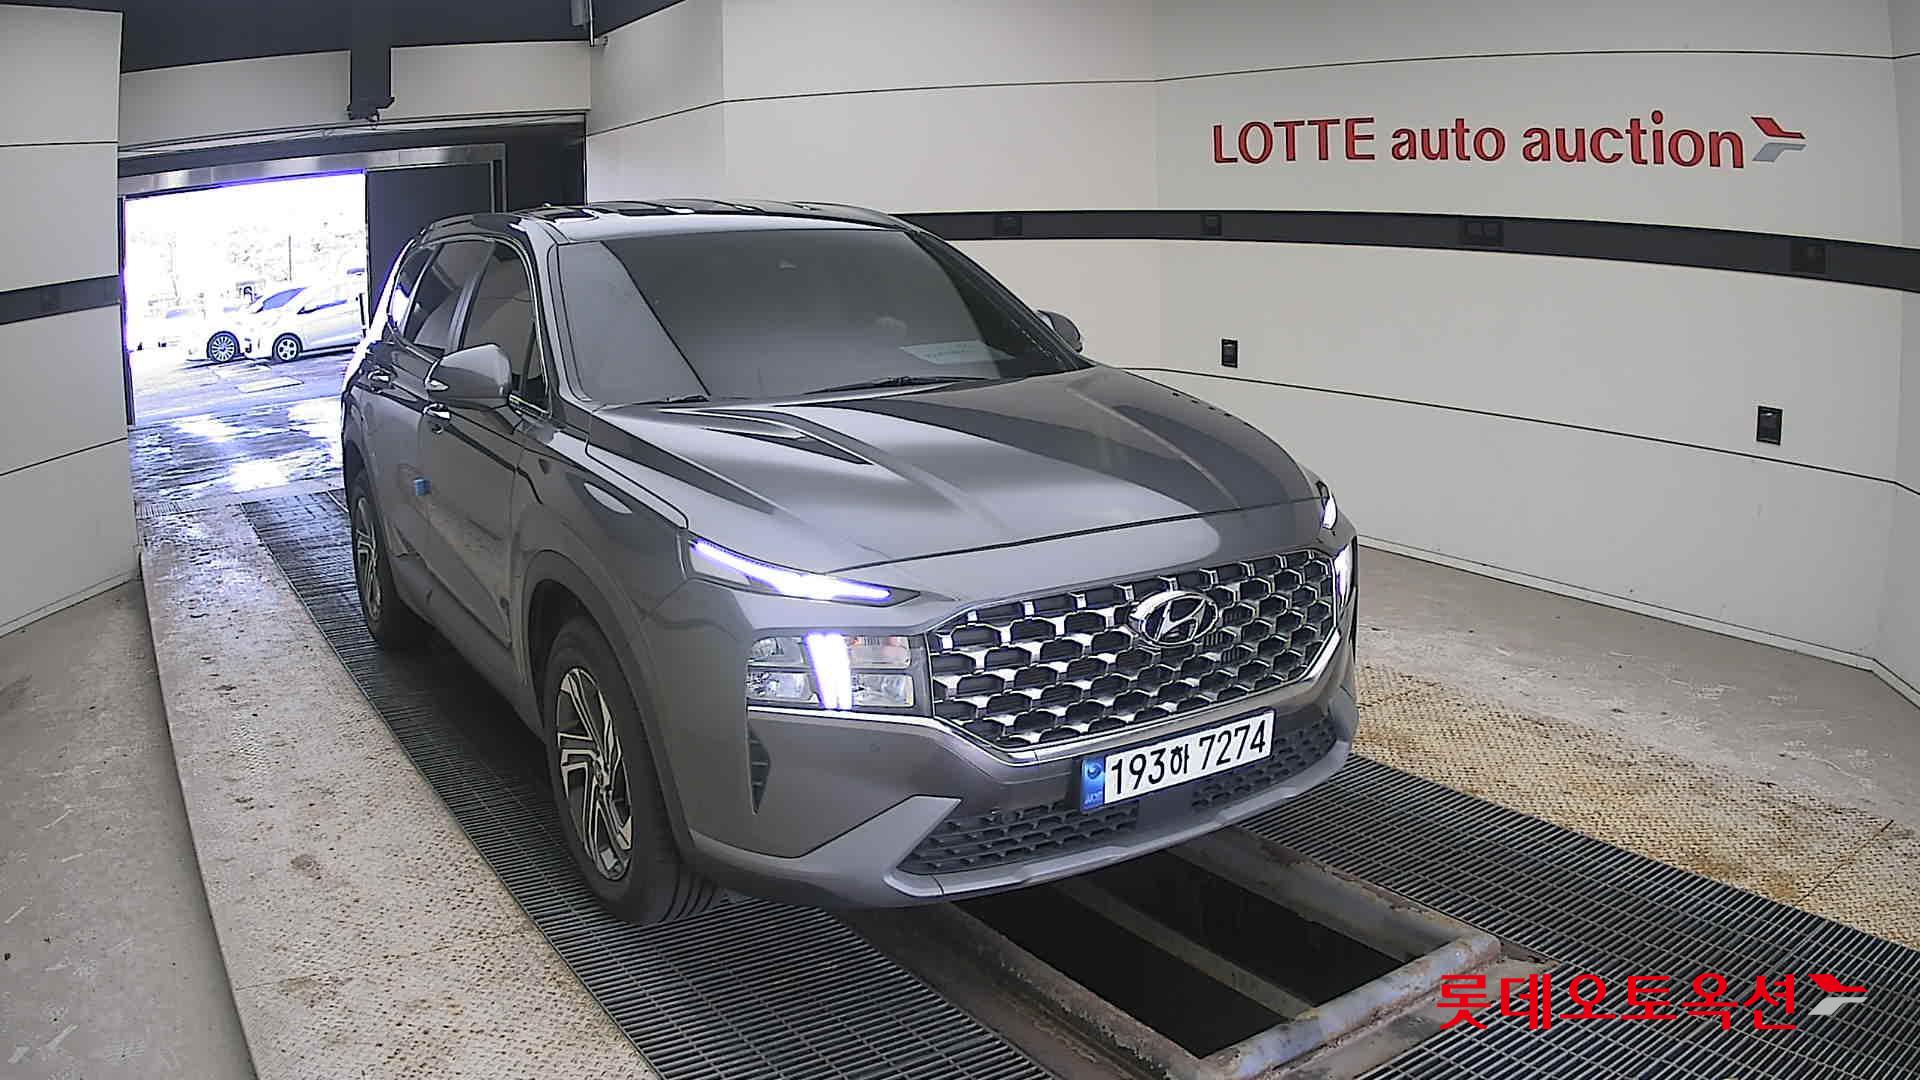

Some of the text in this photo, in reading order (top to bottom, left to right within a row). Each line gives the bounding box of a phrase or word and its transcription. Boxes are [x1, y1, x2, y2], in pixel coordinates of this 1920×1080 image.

[1212, 110, 1745, 169] LOTTE auto auction
[1110, 719, 1266, 795] 193하 7274
